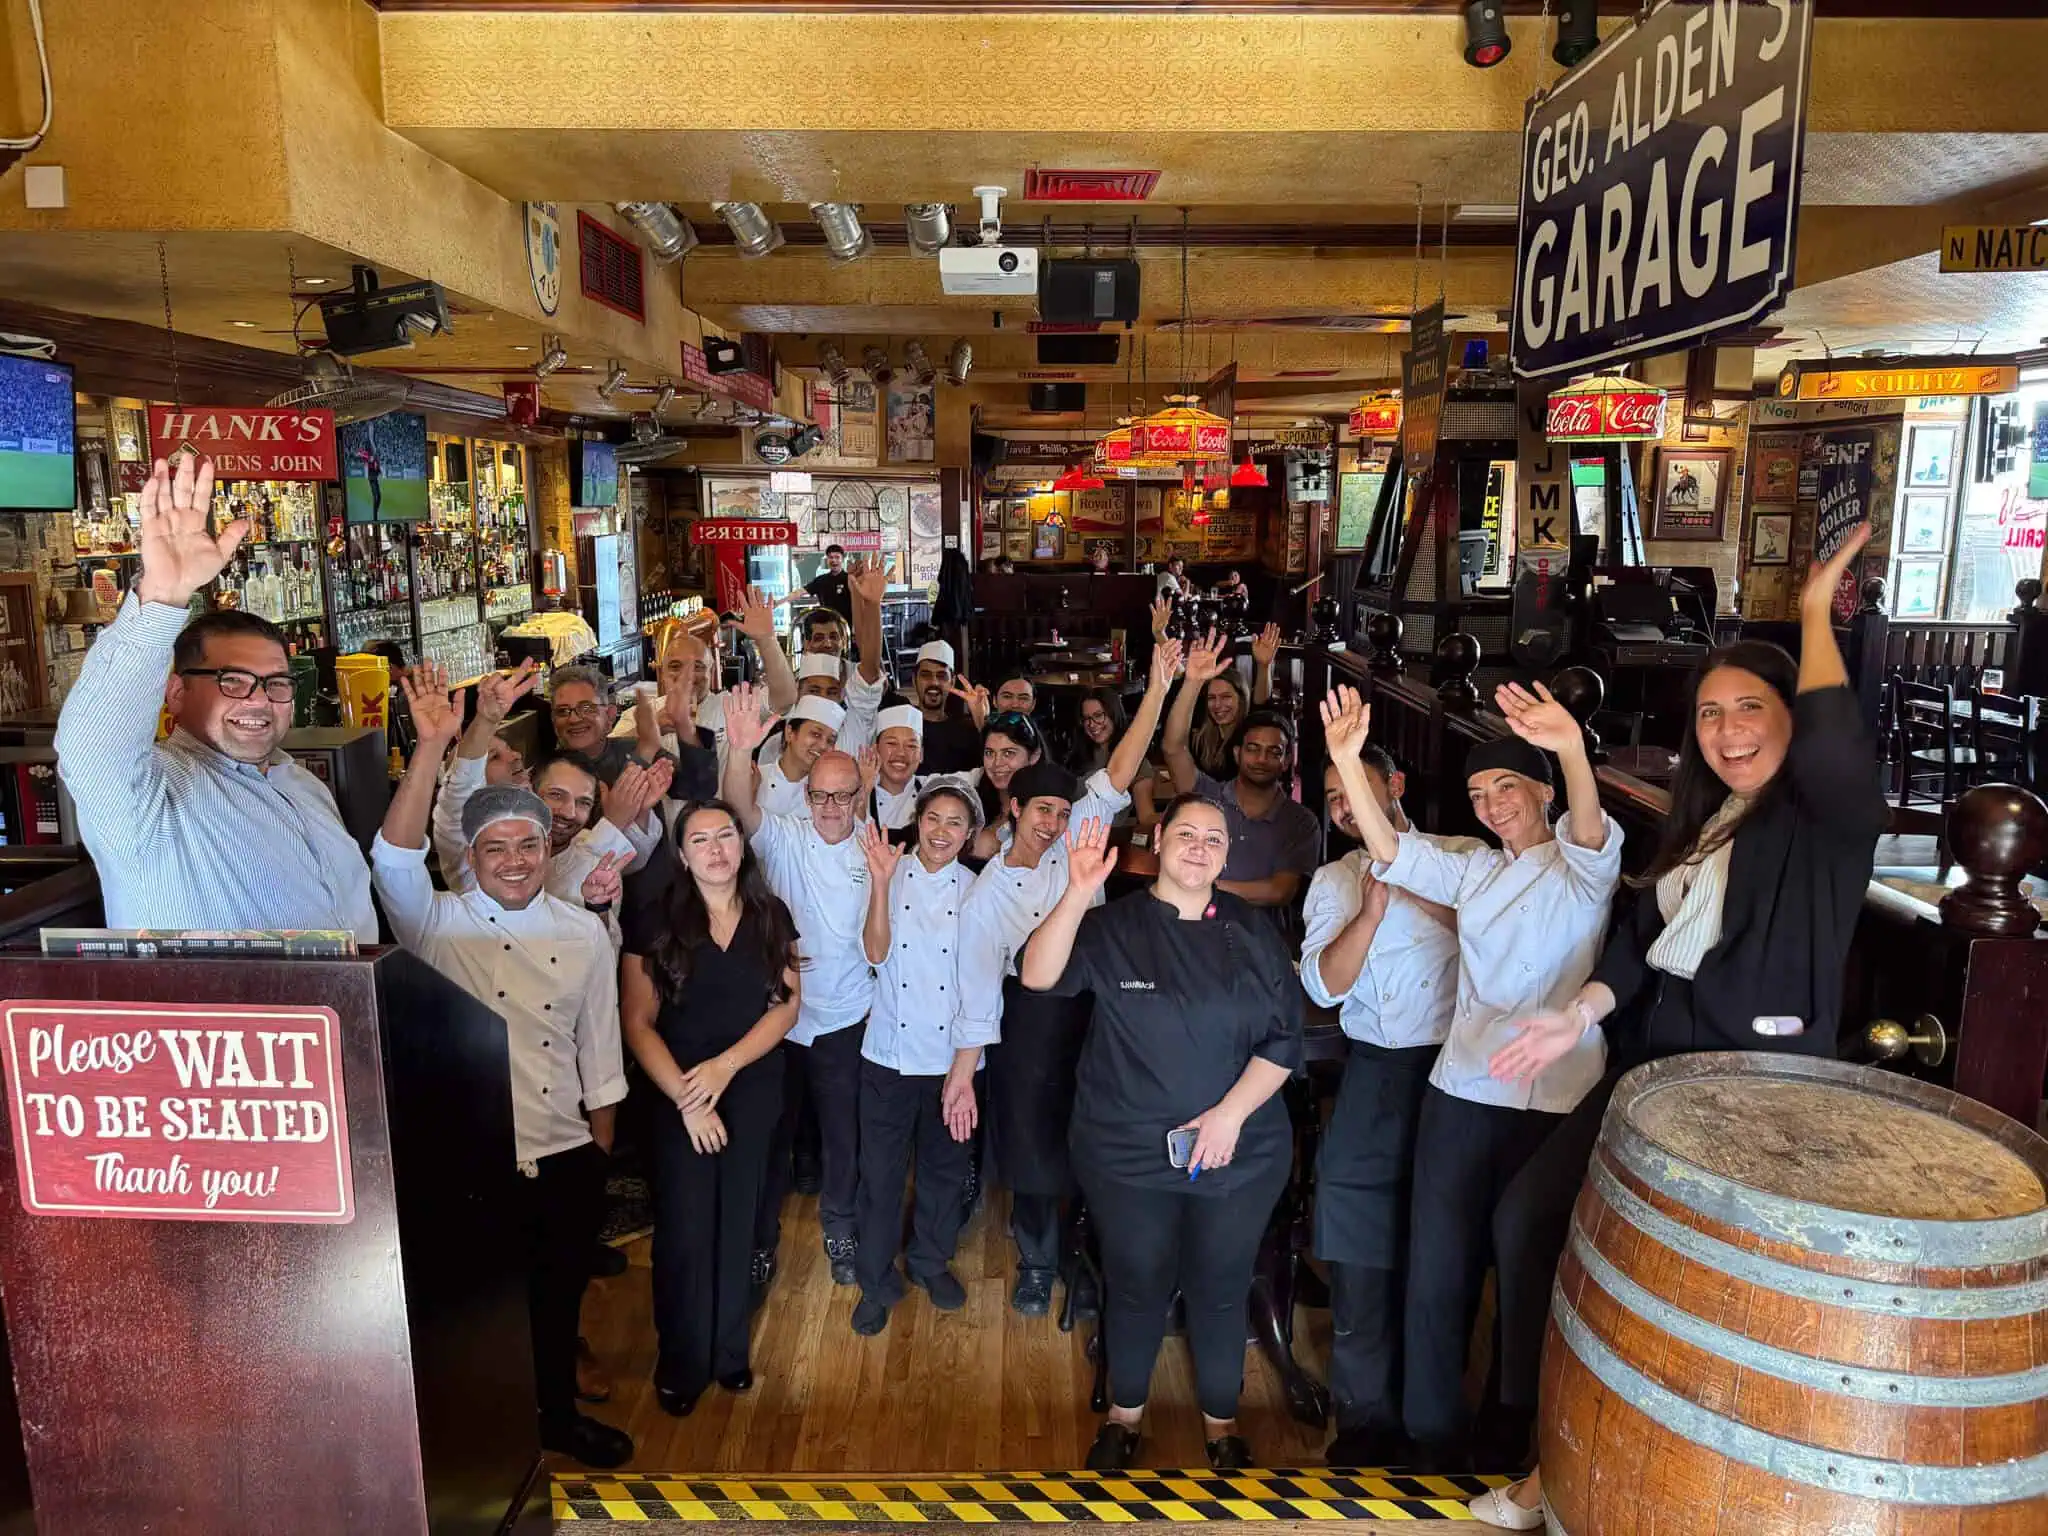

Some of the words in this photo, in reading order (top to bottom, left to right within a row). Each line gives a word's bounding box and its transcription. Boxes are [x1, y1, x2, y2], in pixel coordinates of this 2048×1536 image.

[1532, 101, 1594, 202] GEO.
[1605, 0, 1791, 164] ALDENS
[1522, 85, 1784, 350] GARAGE
[1949, 236, 1965, 261] N
[1856, 372, 1965, 393] SCHLITZ
[1764, 402, 1798, 418] Noel
[158, 413, 323, 442] HANK'S
[270, 455, 322, 472] JOHN
[1009, 443, 1031, 455] avid
[29, 1023, 158, 1079] Please
[158, 1029, 320, 1089] WAIT
[26, 1092, 85, 1138] TO
[94, 1095, 152, 1139] BE
[159, 1096, 330, 1143] SEATED
[85, 1151, 193, 1195] Thank
[201, 1165, 281, 1209] you!
